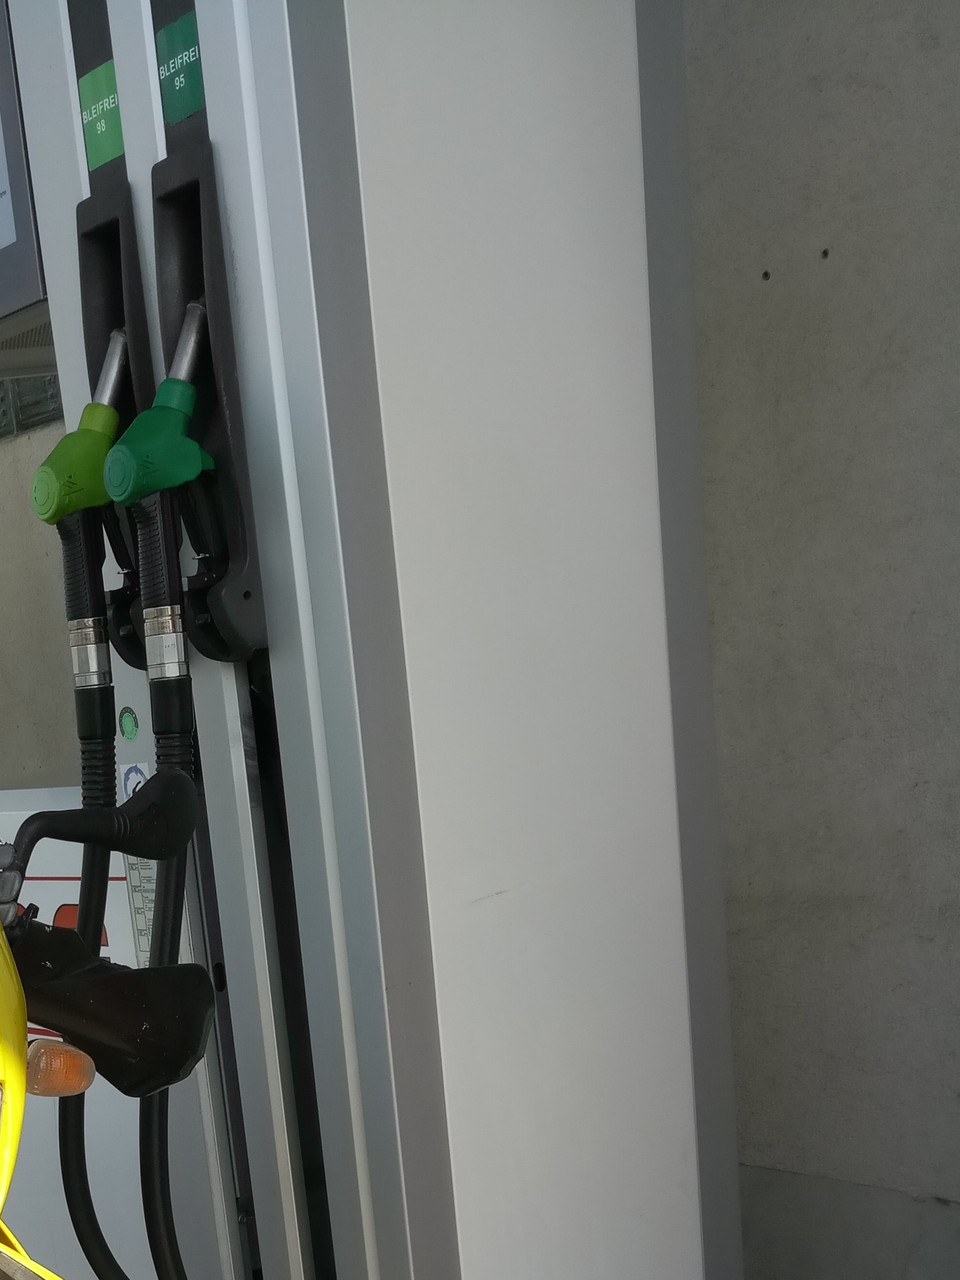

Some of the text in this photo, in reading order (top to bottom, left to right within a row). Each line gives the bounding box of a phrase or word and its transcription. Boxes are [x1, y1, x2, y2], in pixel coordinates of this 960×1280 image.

[159, 45, 199, 80] BLEIFREI
[174, 73, 185, 90] 95
[82, 93, 118, 124] BLEIFREI
[96, 119, 106, 134] 98
